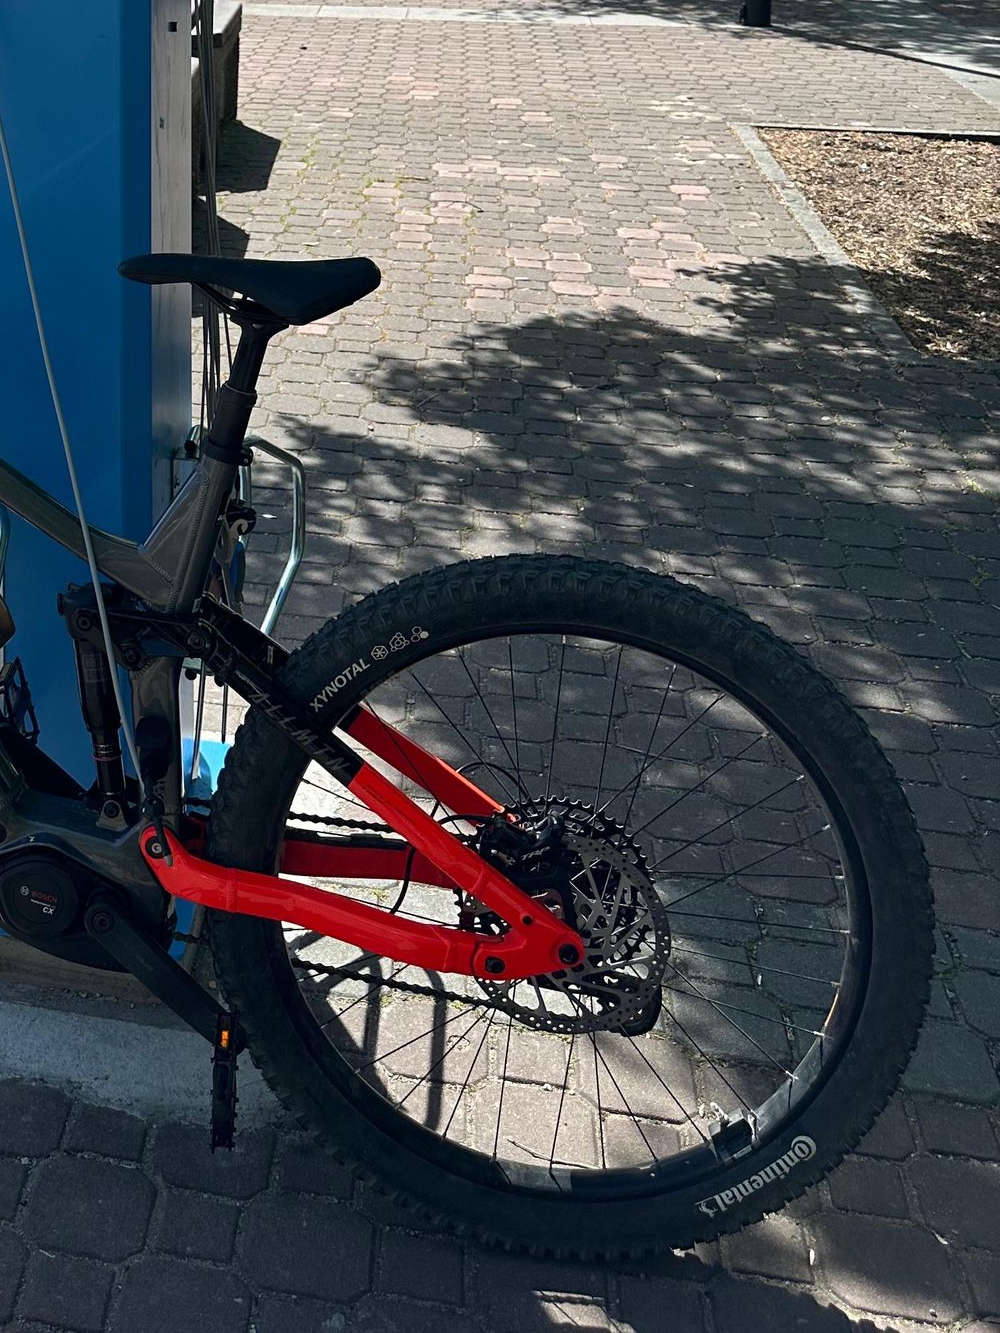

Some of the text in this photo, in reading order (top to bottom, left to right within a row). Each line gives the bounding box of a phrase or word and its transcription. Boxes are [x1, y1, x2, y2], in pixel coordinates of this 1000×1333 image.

[309, 657, 371, 713] XYNOTAL
[42, 906, 55, 915] CX
[712, 1135, 817, 1212] Continental
